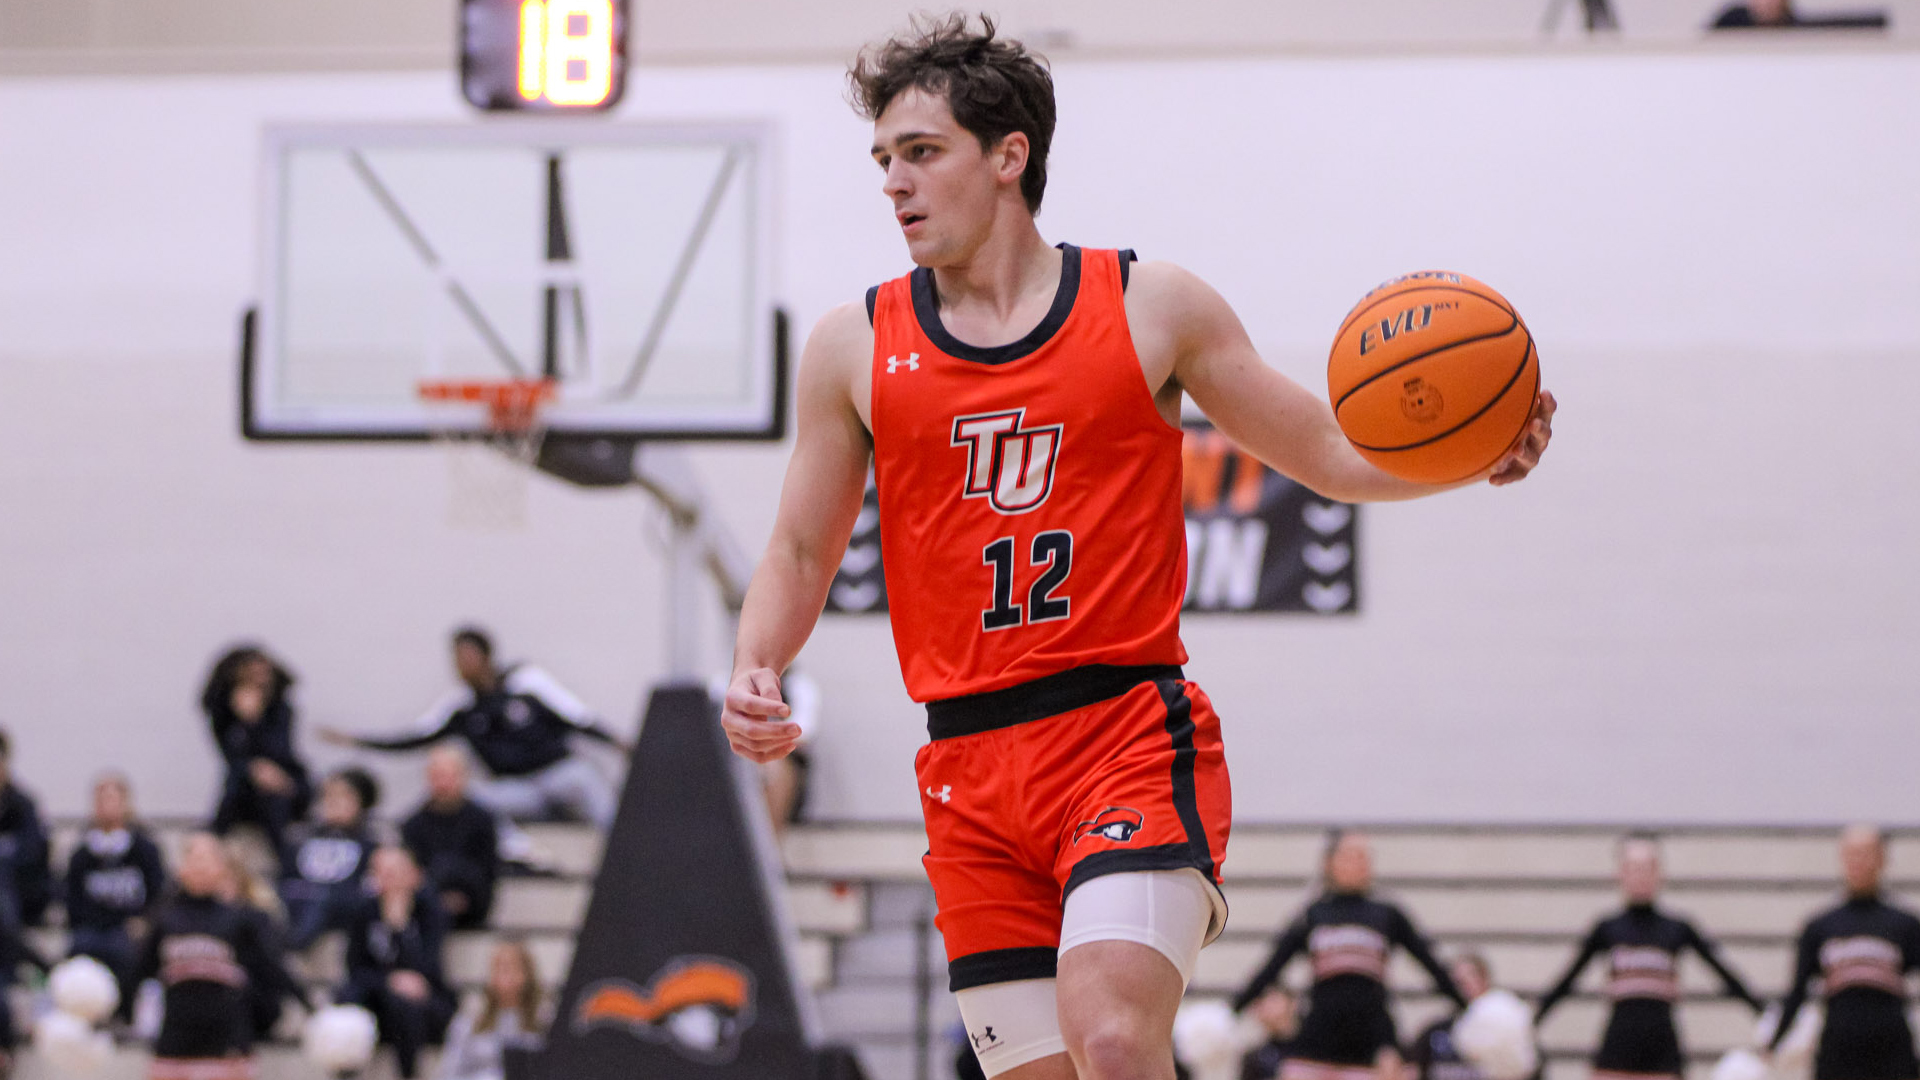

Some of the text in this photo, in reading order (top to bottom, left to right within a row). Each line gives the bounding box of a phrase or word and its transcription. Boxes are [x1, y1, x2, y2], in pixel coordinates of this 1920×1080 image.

[517, 0, 613, 107] 18
[1360, 304, 1432, 356] EVO
[950, 407, 1064, 516] TU
[982, 529, 1074, 633] 12
